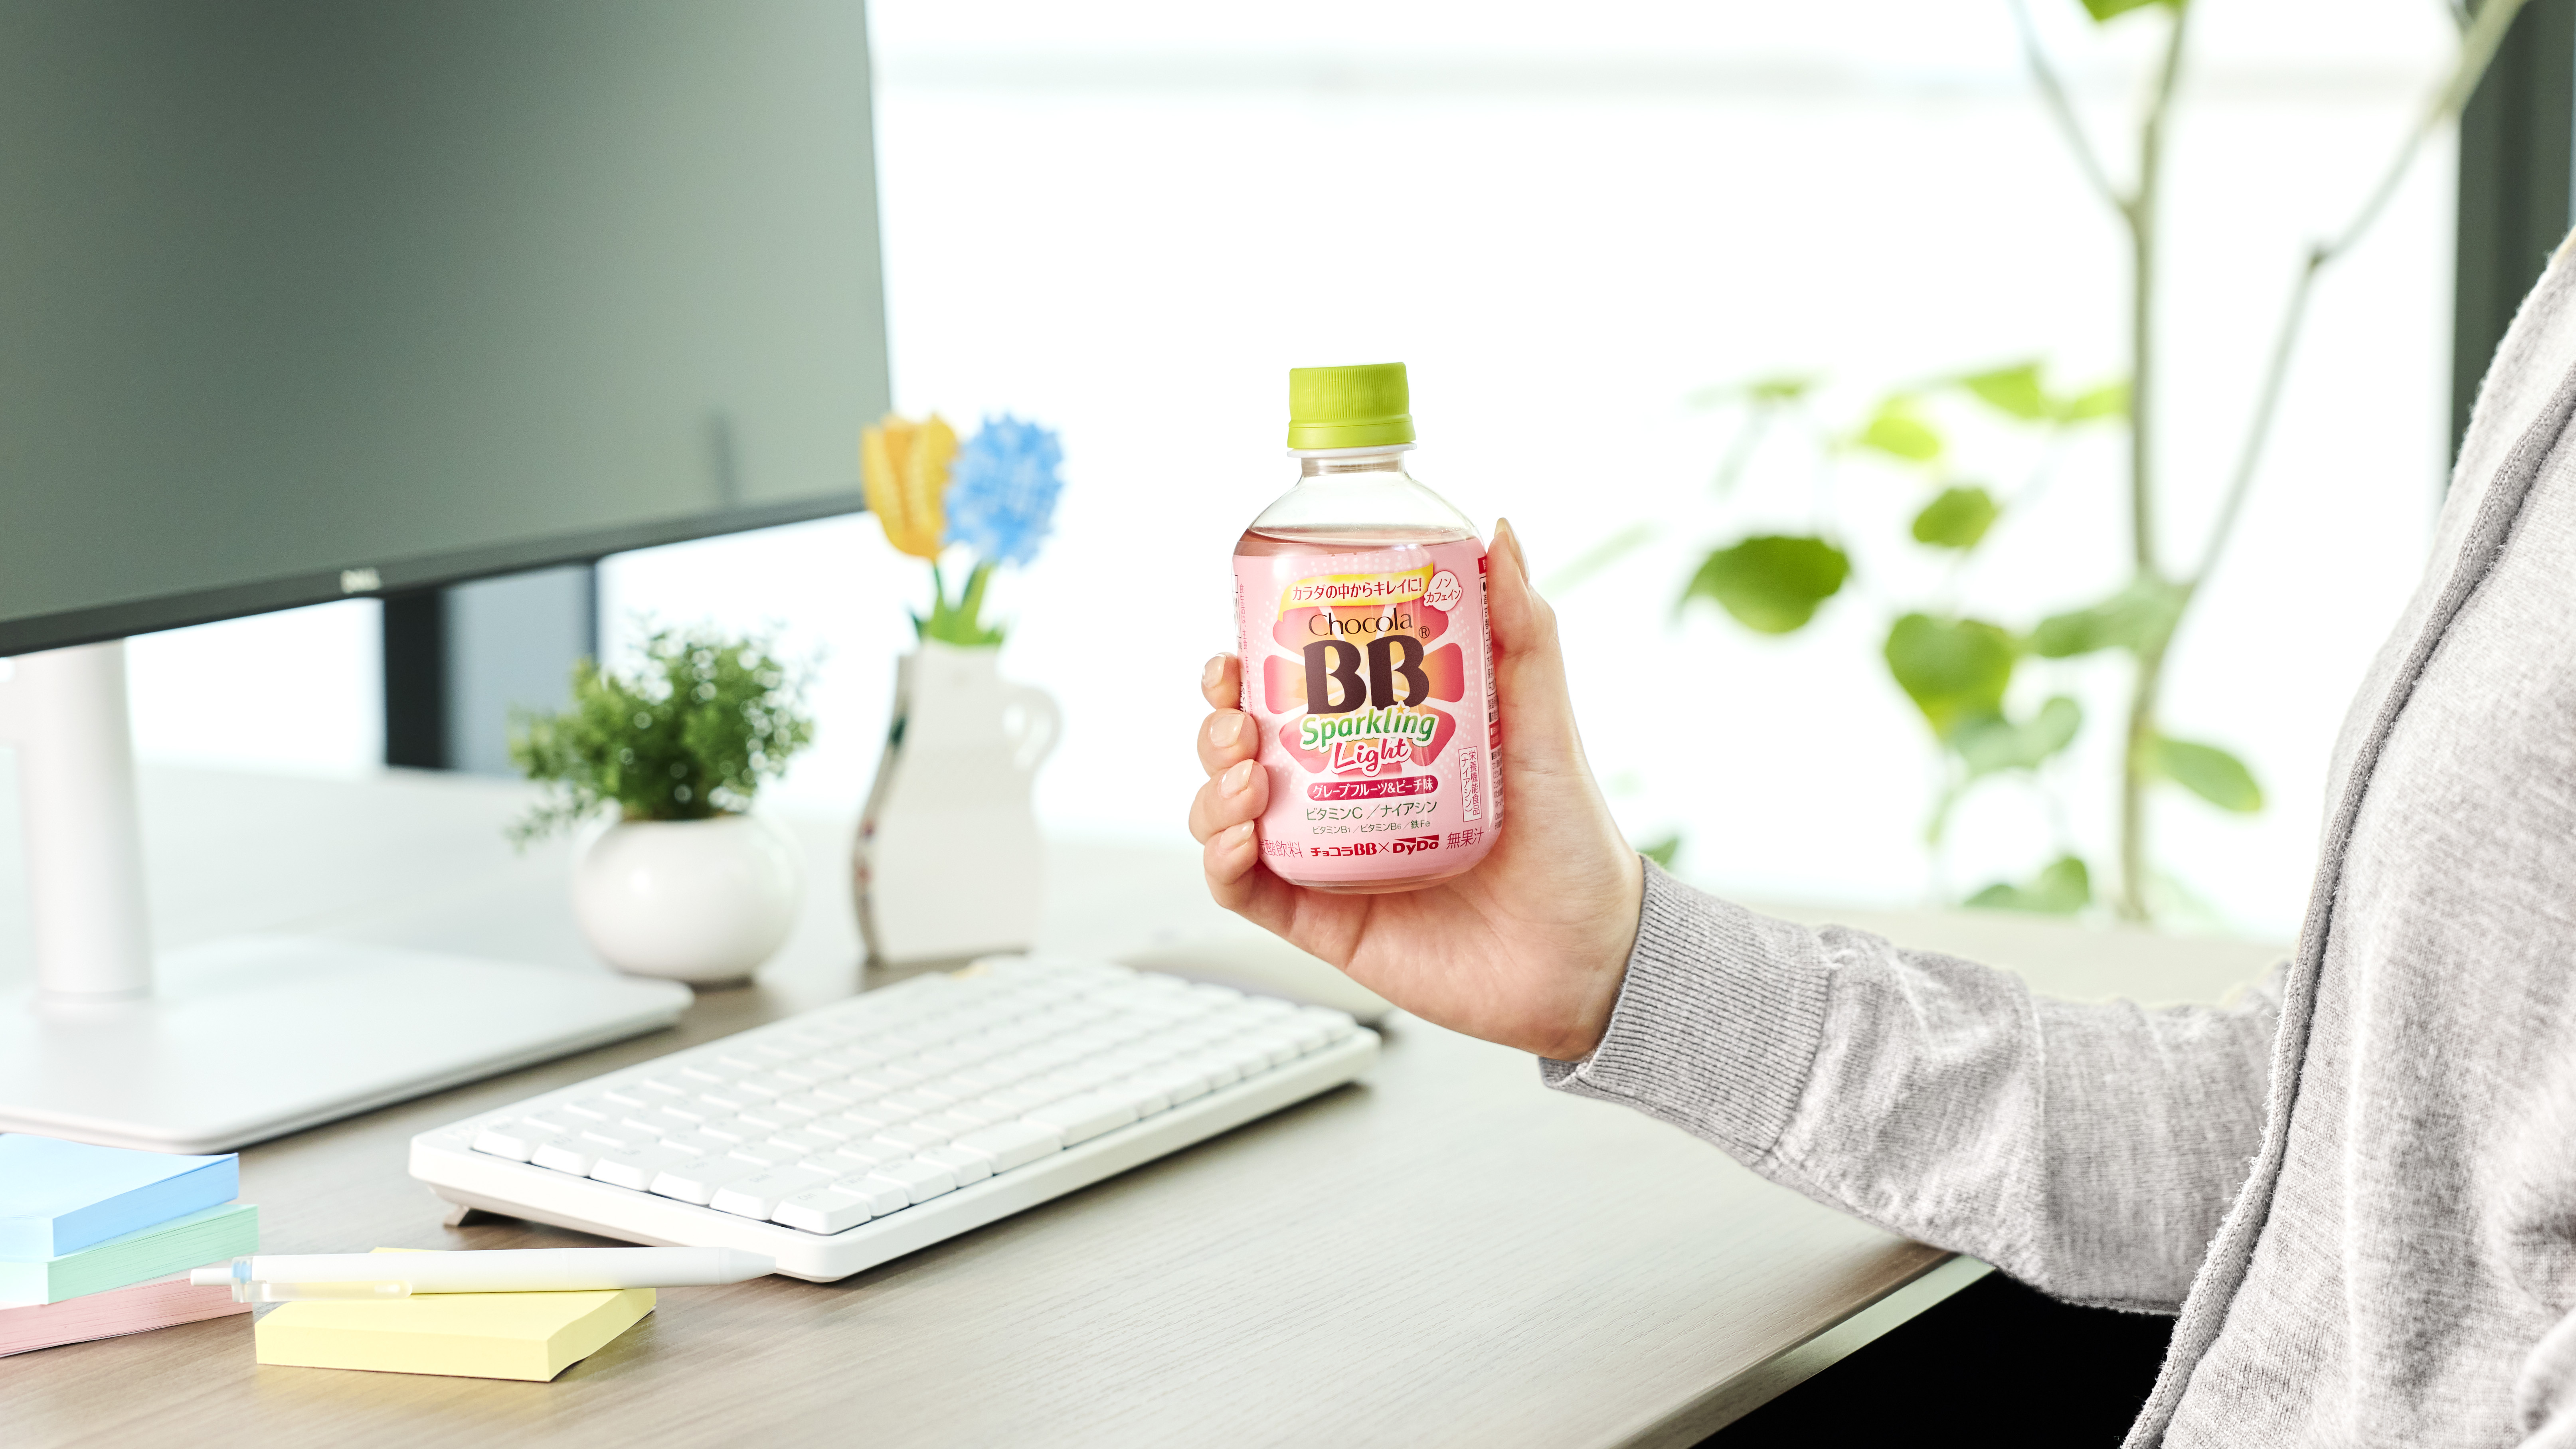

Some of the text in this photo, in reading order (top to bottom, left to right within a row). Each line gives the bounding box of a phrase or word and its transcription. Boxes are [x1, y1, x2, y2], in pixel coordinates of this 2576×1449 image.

[1292, 577, 1422, 601] カラダの中からキレイに!
[1436, 578, 1452, 589] ノン
[1426, 589, 1461, 604] カフェイン
[1308, 607, 1413, 636] Chocola
[1303, 635, 1429, 714] BB
[1302, 706, 1436, 747] Sparkling
[1334, 738, 1409, 772] Light
[1313, 777, 1434, 798] グレープフルーツ&ピーチ味
[1468, 750, 1480, 816] 栄養機能食品
[1446, 826, 1484, 850] 無果汁
[749, 1173, 773, 1183] Shift
[797, 1192, 817, 1201] Ctrl
